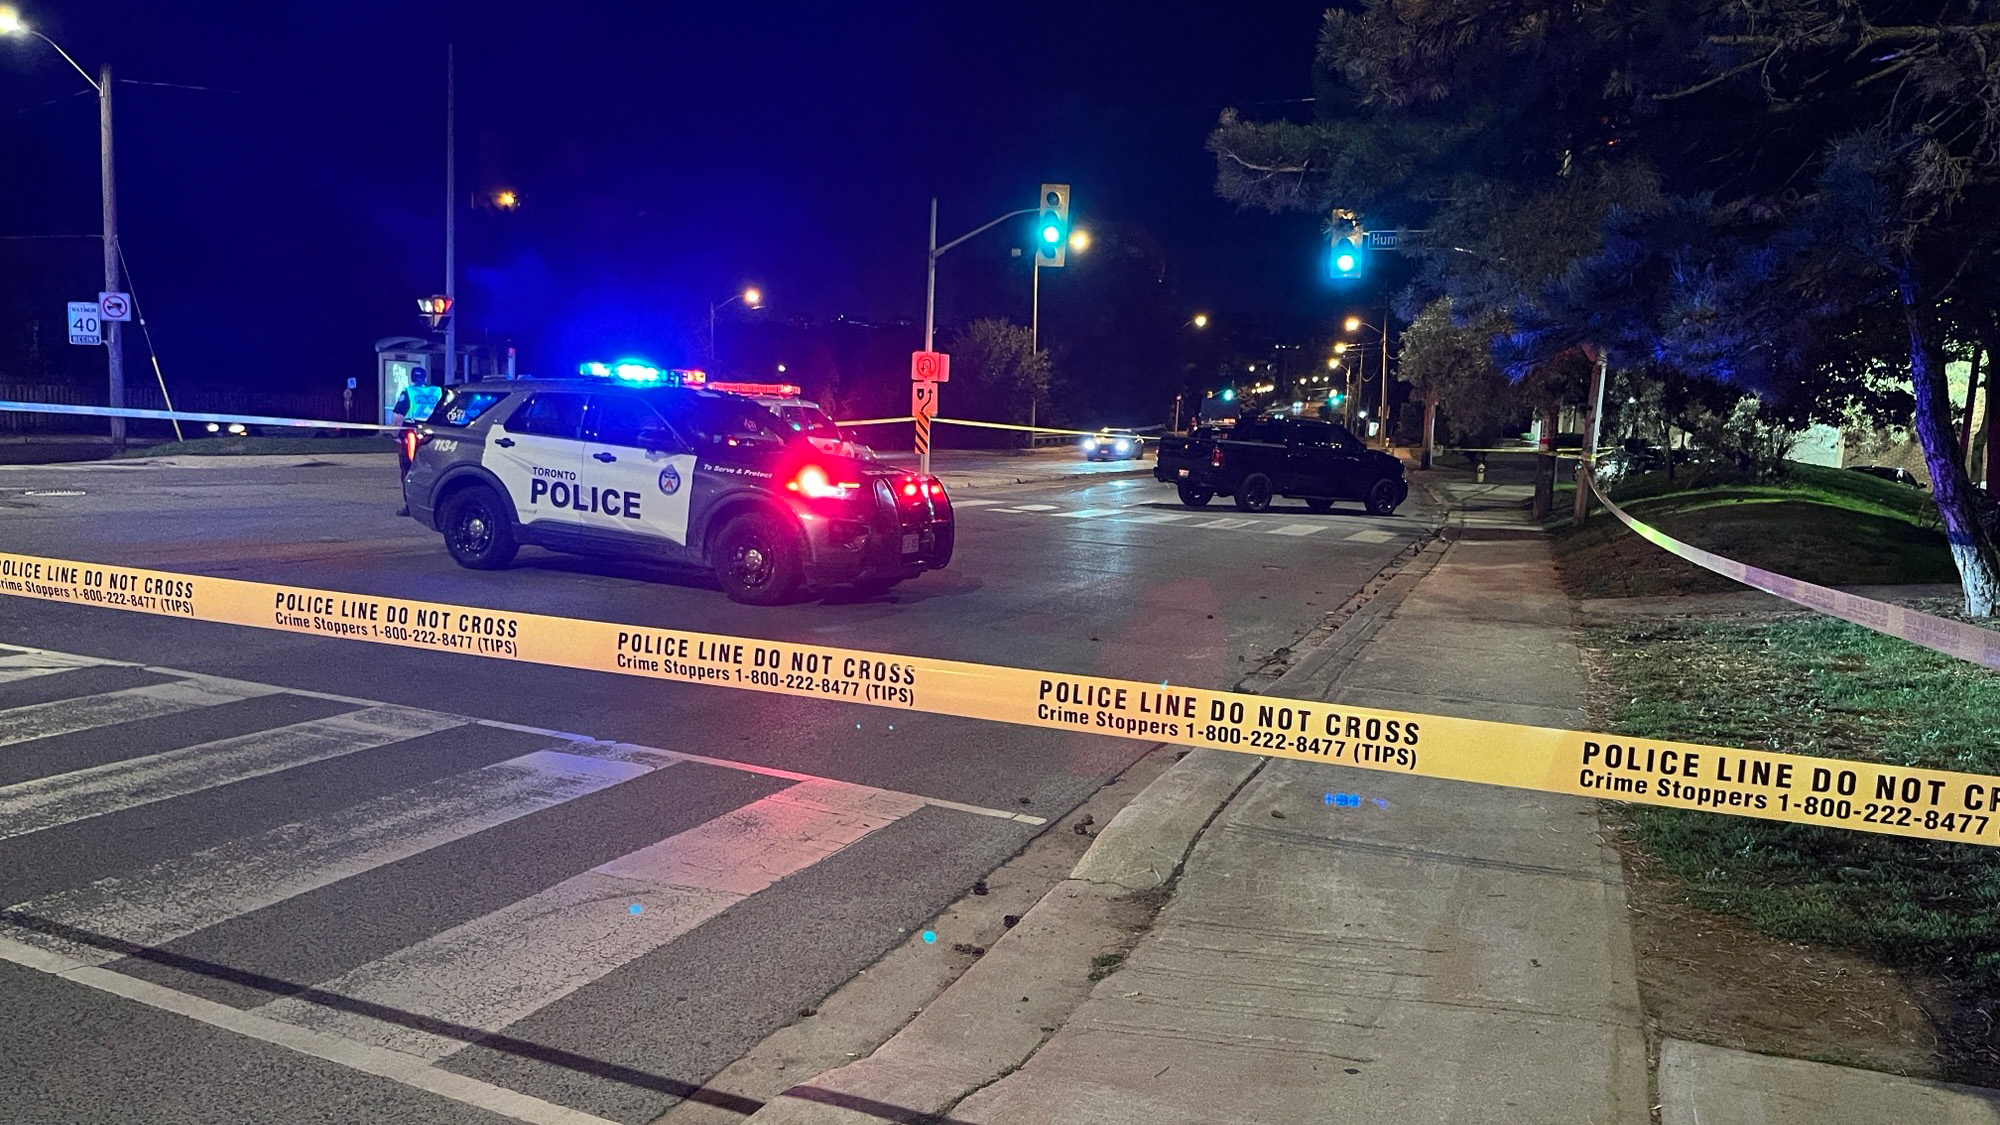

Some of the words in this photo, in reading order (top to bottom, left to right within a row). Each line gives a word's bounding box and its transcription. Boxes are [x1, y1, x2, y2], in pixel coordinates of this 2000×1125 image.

[73, 318, 97, 332] 40
[433, 438, 458, 453] 1134
[532, 466, 577, 481] TORONTO
[703, 463, 713, 471] To
[713, 465, 736, 475] Serve
[735, 468, 743, 476] &
[743, 468, 773, 479] Protect
[530, 477, 641, 520] POLICE
[0, 559, 41, 580] OLICE
[47, 565, 78, 584] LINE
[84, 570, 103, 588] DO
[109, 573, 138, 592] NOT
[144, 577, 194, 599] CROSS
[0, 577, 23, 592] rime
[25, 580, 70, 598] Stoppers
[72, 587, 156, 609] 1-800-222-8477
[160, 598, 195, 616] (TIPS)
[275, 592, 334, 616] POLICE
[341, 600, 379, 621] LINE
[386, 605, 408, 625] DO
[417, 609, 451, 630] NOT
[459, 614, 518, 638] CROSS
[275, 611, 310, 628] Crime
[313, 616, 368, 636] Stoppers
[371, 624, 472, 649] 1-800-222-8477
[477, 637, 517, 658] (TIPS)
[617, 632, 689, 658] POLICE
[698, 641, 744, 665] LINE
[754, 647, 781, 669] DO
[791, 651, 833, 675] NOT
[843, 658, 915, 686] CROSS
[617, 653, 659, 672] Crime
[664, 659, 730, 681] Stoppers
[735, 668, 860, 697] 1-800-222-8477
[865, 683, 914, 707] (TIPS)
[1039, 679, 1127, 710] POLICE
[1140, 691, 1197, 719] LINE
[1210, 699, 1244, 725] DO
[1258, 705, 1311, 732] NOT
[1325, 713, 1420, 746] CROSS
[1037, 703, 1089, 725] Crime
[1095, 710, 1179, 736] Stoppers
[1185, 722, 1346, 758] 1-800-222-8477
[1353, 742, 1417, 771] (TIPS)
[1582, 741, 1700, 778] POLICE
[1716, 756, 1793, 789] LINE
[1811, 767, 1857, 796] DO
[1875, 774, 1946, 806] NOT
[1579, 768, 1648, 795] Crime
[1656, 777, 1768, 810] Stoppers
[1777, 793, 1990, 836] 1-800-222-8477
